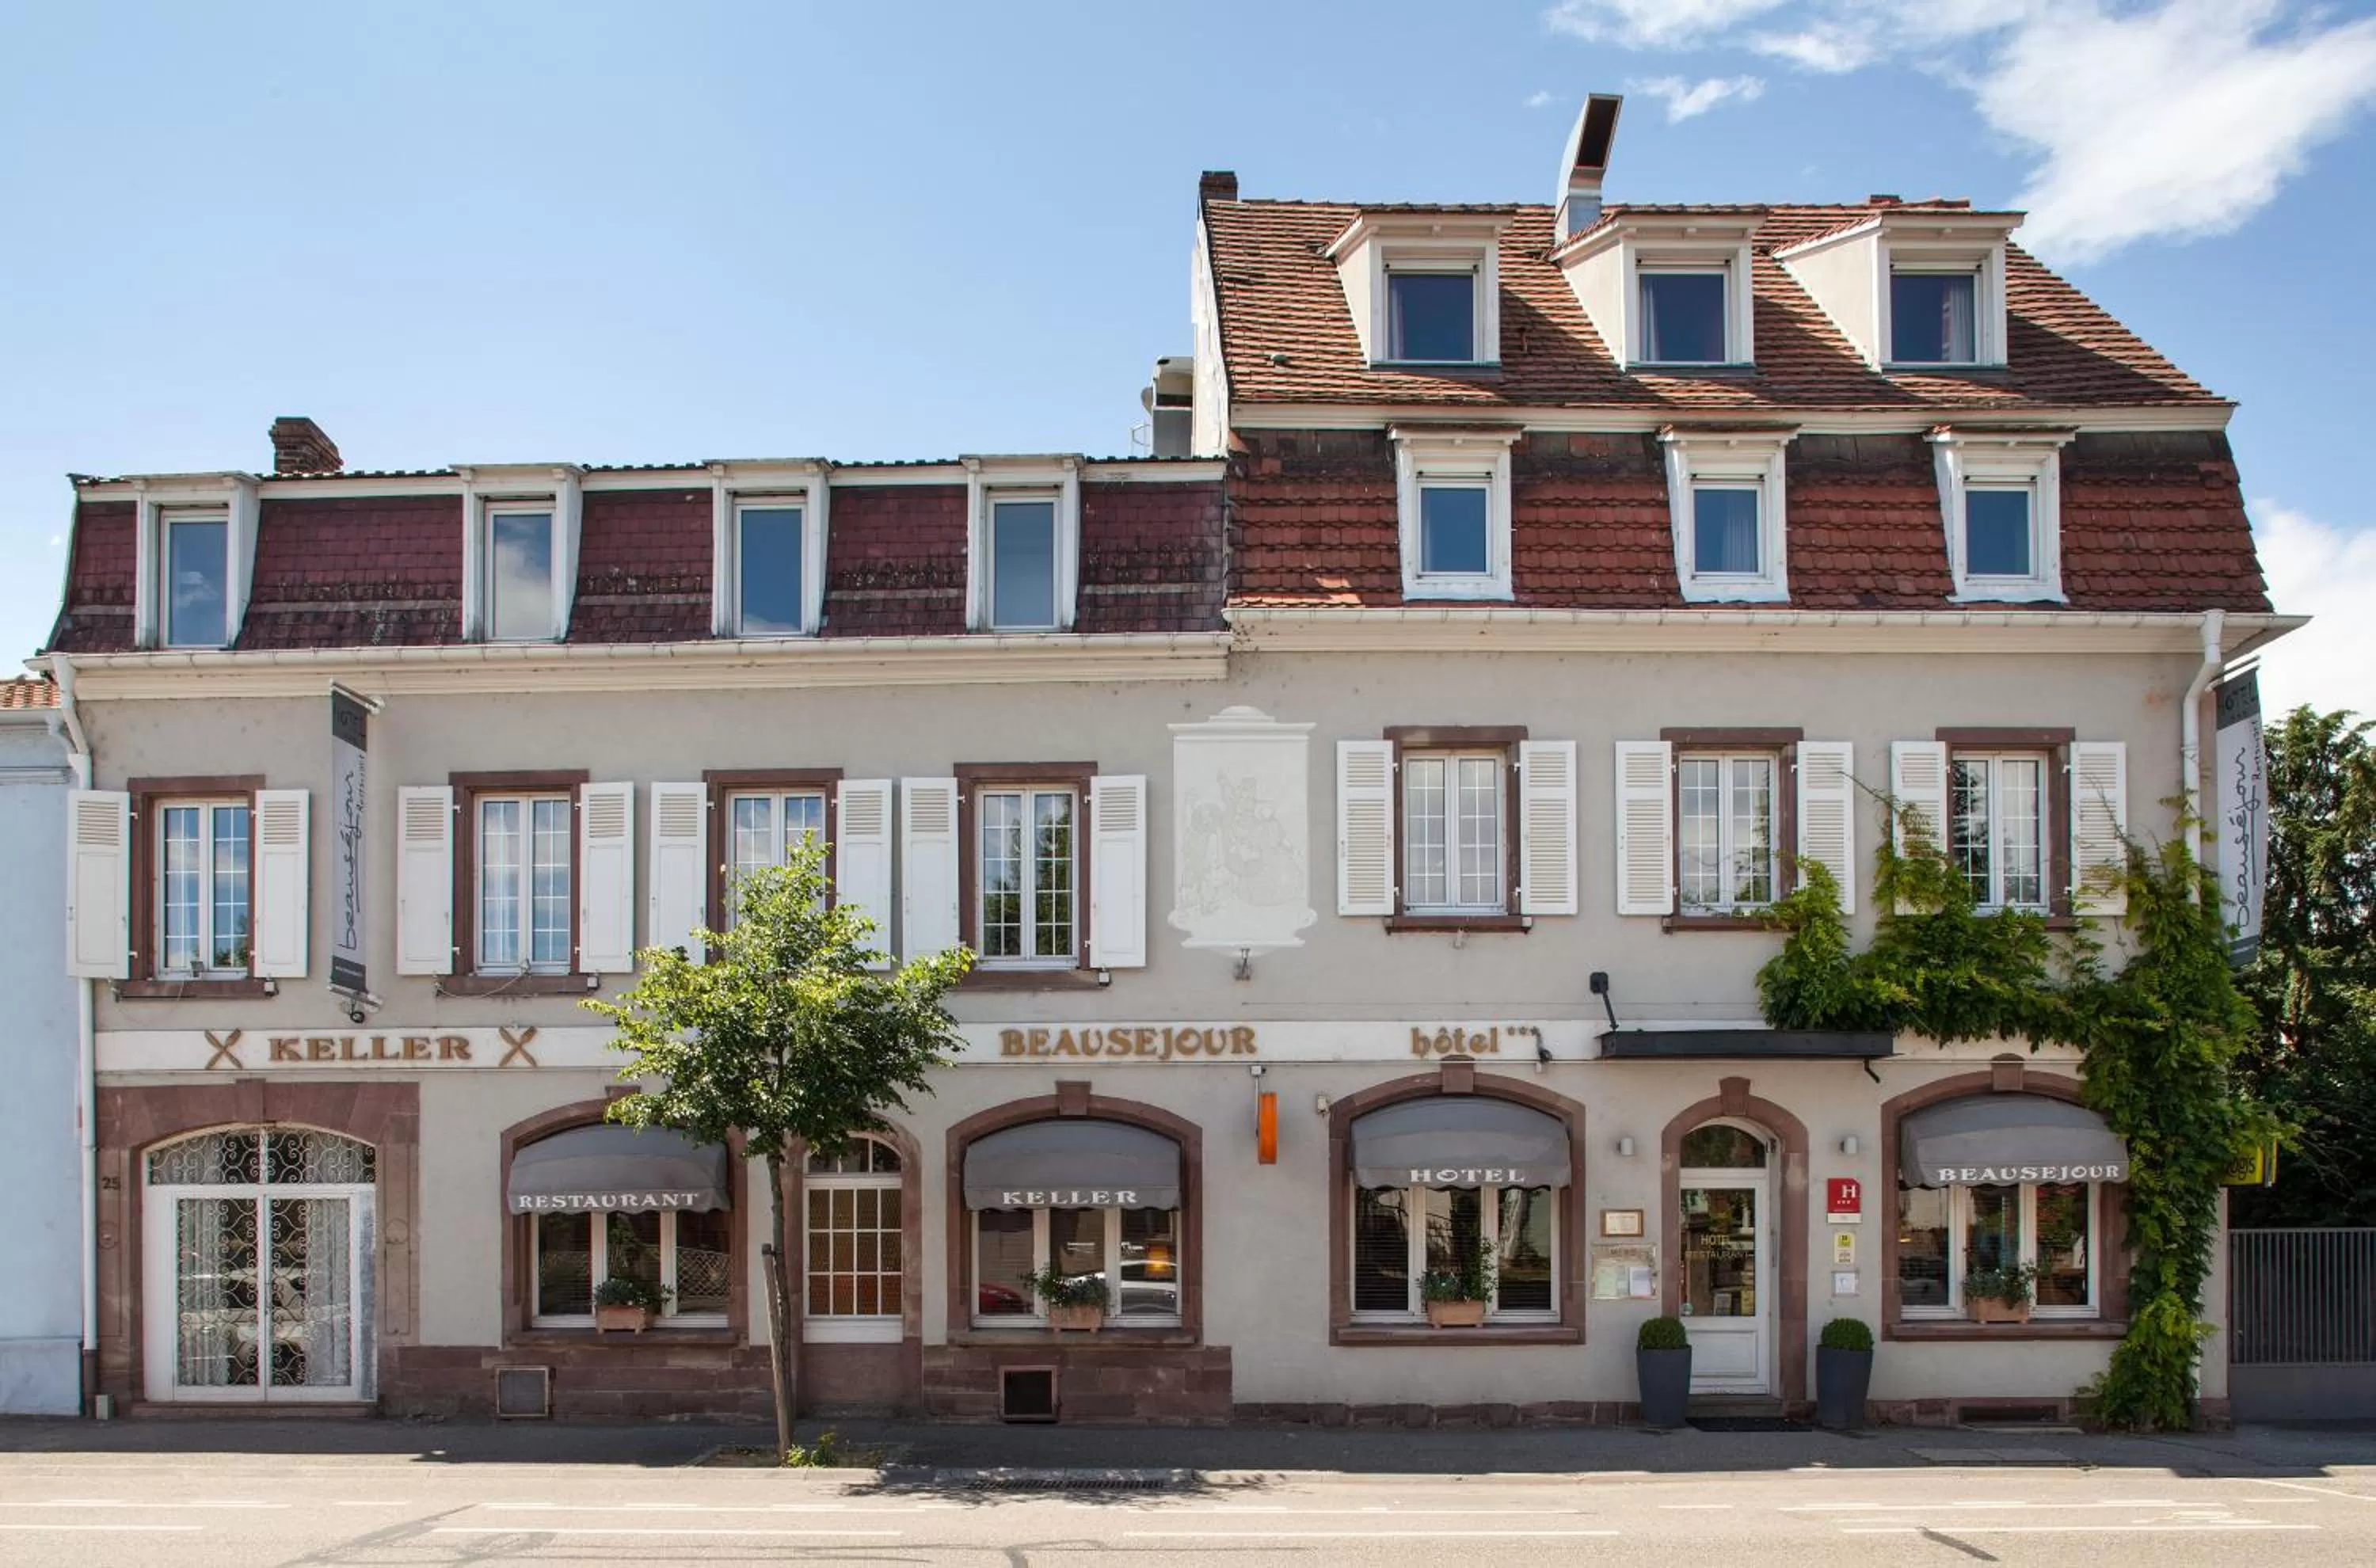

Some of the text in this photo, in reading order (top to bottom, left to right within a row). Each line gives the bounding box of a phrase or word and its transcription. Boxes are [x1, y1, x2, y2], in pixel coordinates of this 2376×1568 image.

[268, 1037, 473, 1062] KELLER
[999, 1026, 1257, 1060] BEAUSEJOUR
[1410, 1026, 1499, 1059] hôtel
[1410, 1168, 1525, 1182] HOTEL
[1938, 1165, 2120, 1181] BEAUSEJOUR
[102, 1175, 121, 1190] 25
[1003, 1190, 1138, 1205] KELLER
[1841, 1184, 1856, 1198] H
[519, 1193, 699, 1208] RESTAURANT
